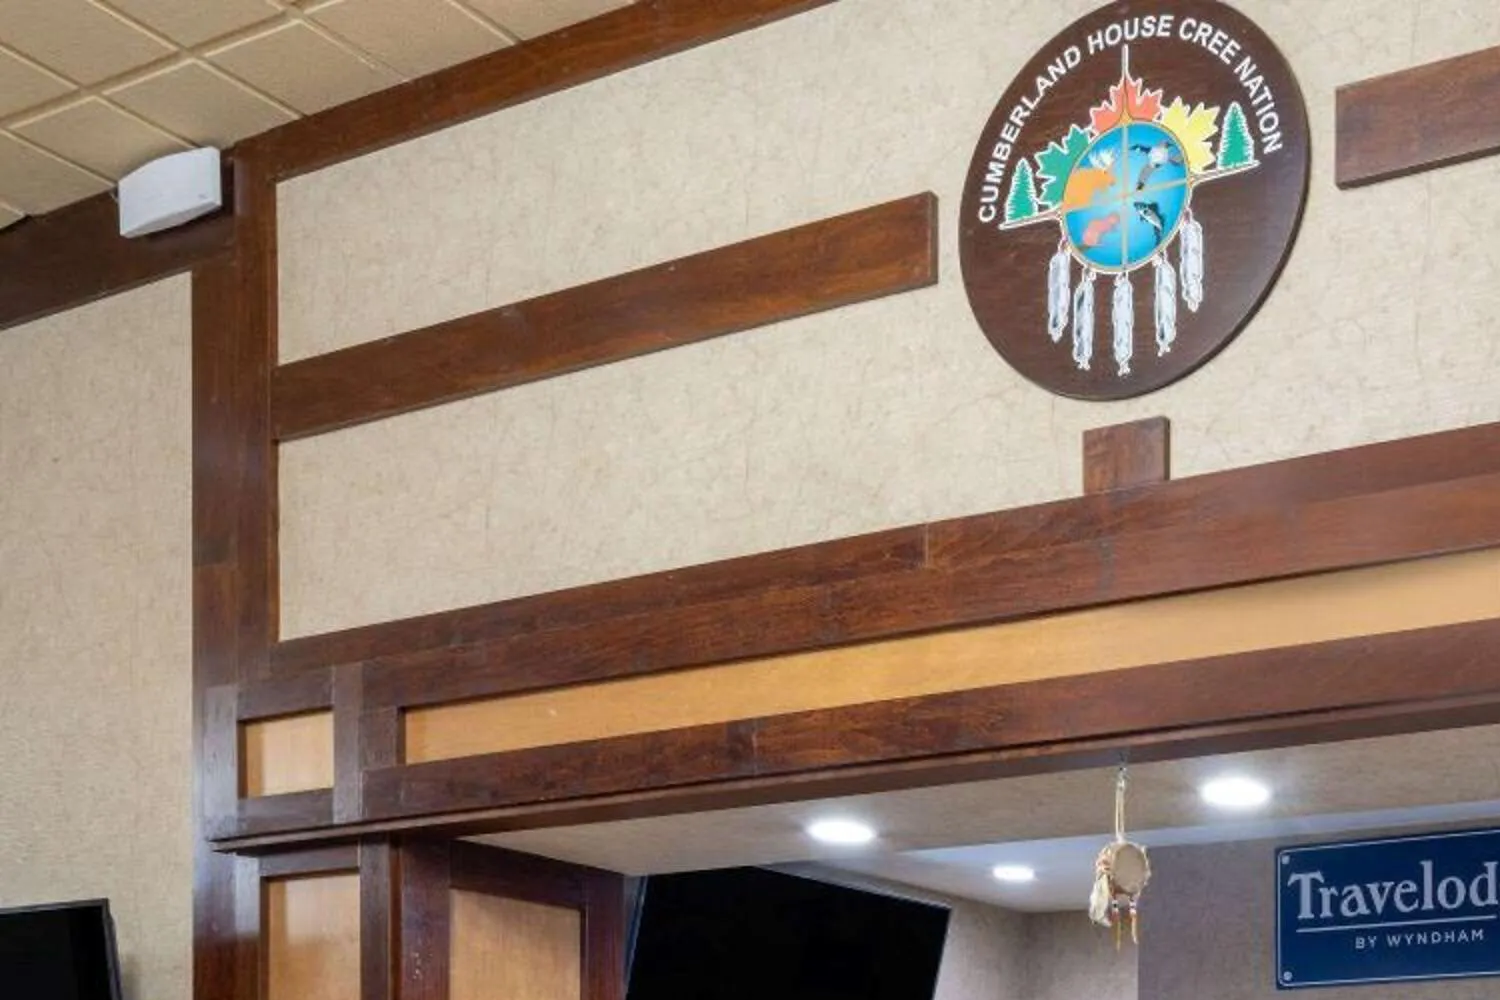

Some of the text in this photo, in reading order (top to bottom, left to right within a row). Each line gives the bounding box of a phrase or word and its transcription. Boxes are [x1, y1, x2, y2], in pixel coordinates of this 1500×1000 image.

[978, 14, 1284, 223] CUMBERLAND HOUSE CREE NATION
[1355, 928, 1485, 950] BY WYNDHAM
